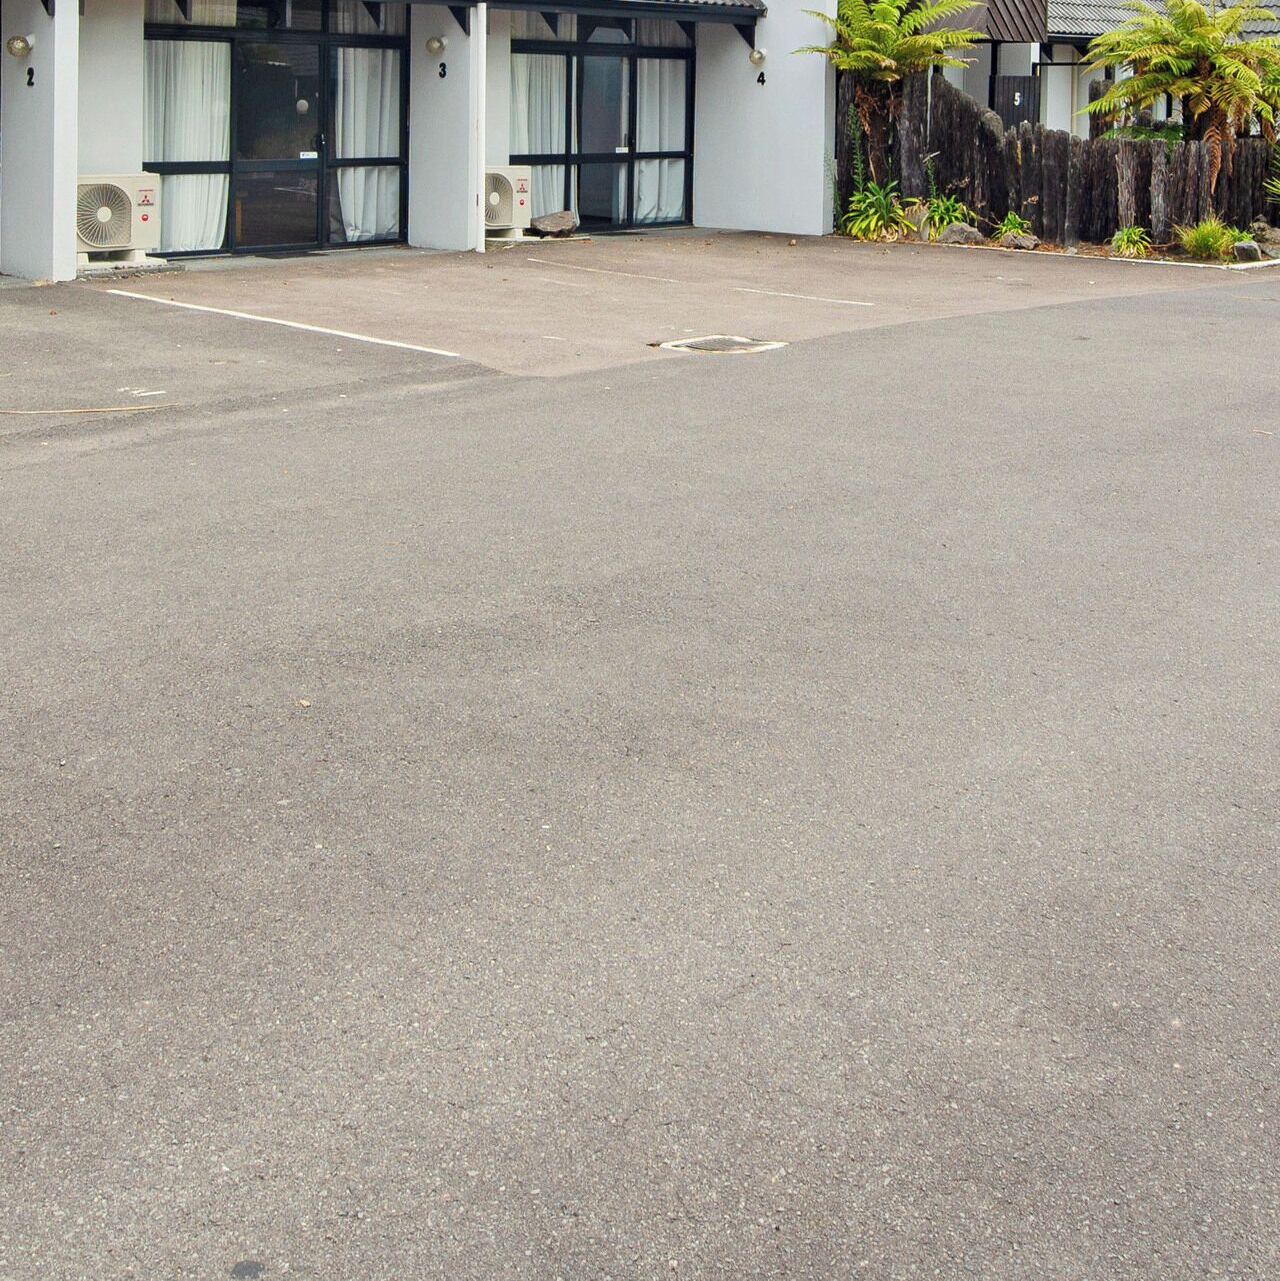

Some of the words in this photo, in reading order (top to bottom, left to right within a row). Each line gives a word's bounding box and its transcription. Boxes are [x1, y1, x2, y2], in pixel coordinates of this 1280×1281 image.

[26, 67, 35, 87] 2
[438, 62, 447, 79] 3
[756, 71, 766, 86] 4
[1013, 92, 1021, 106] 5
